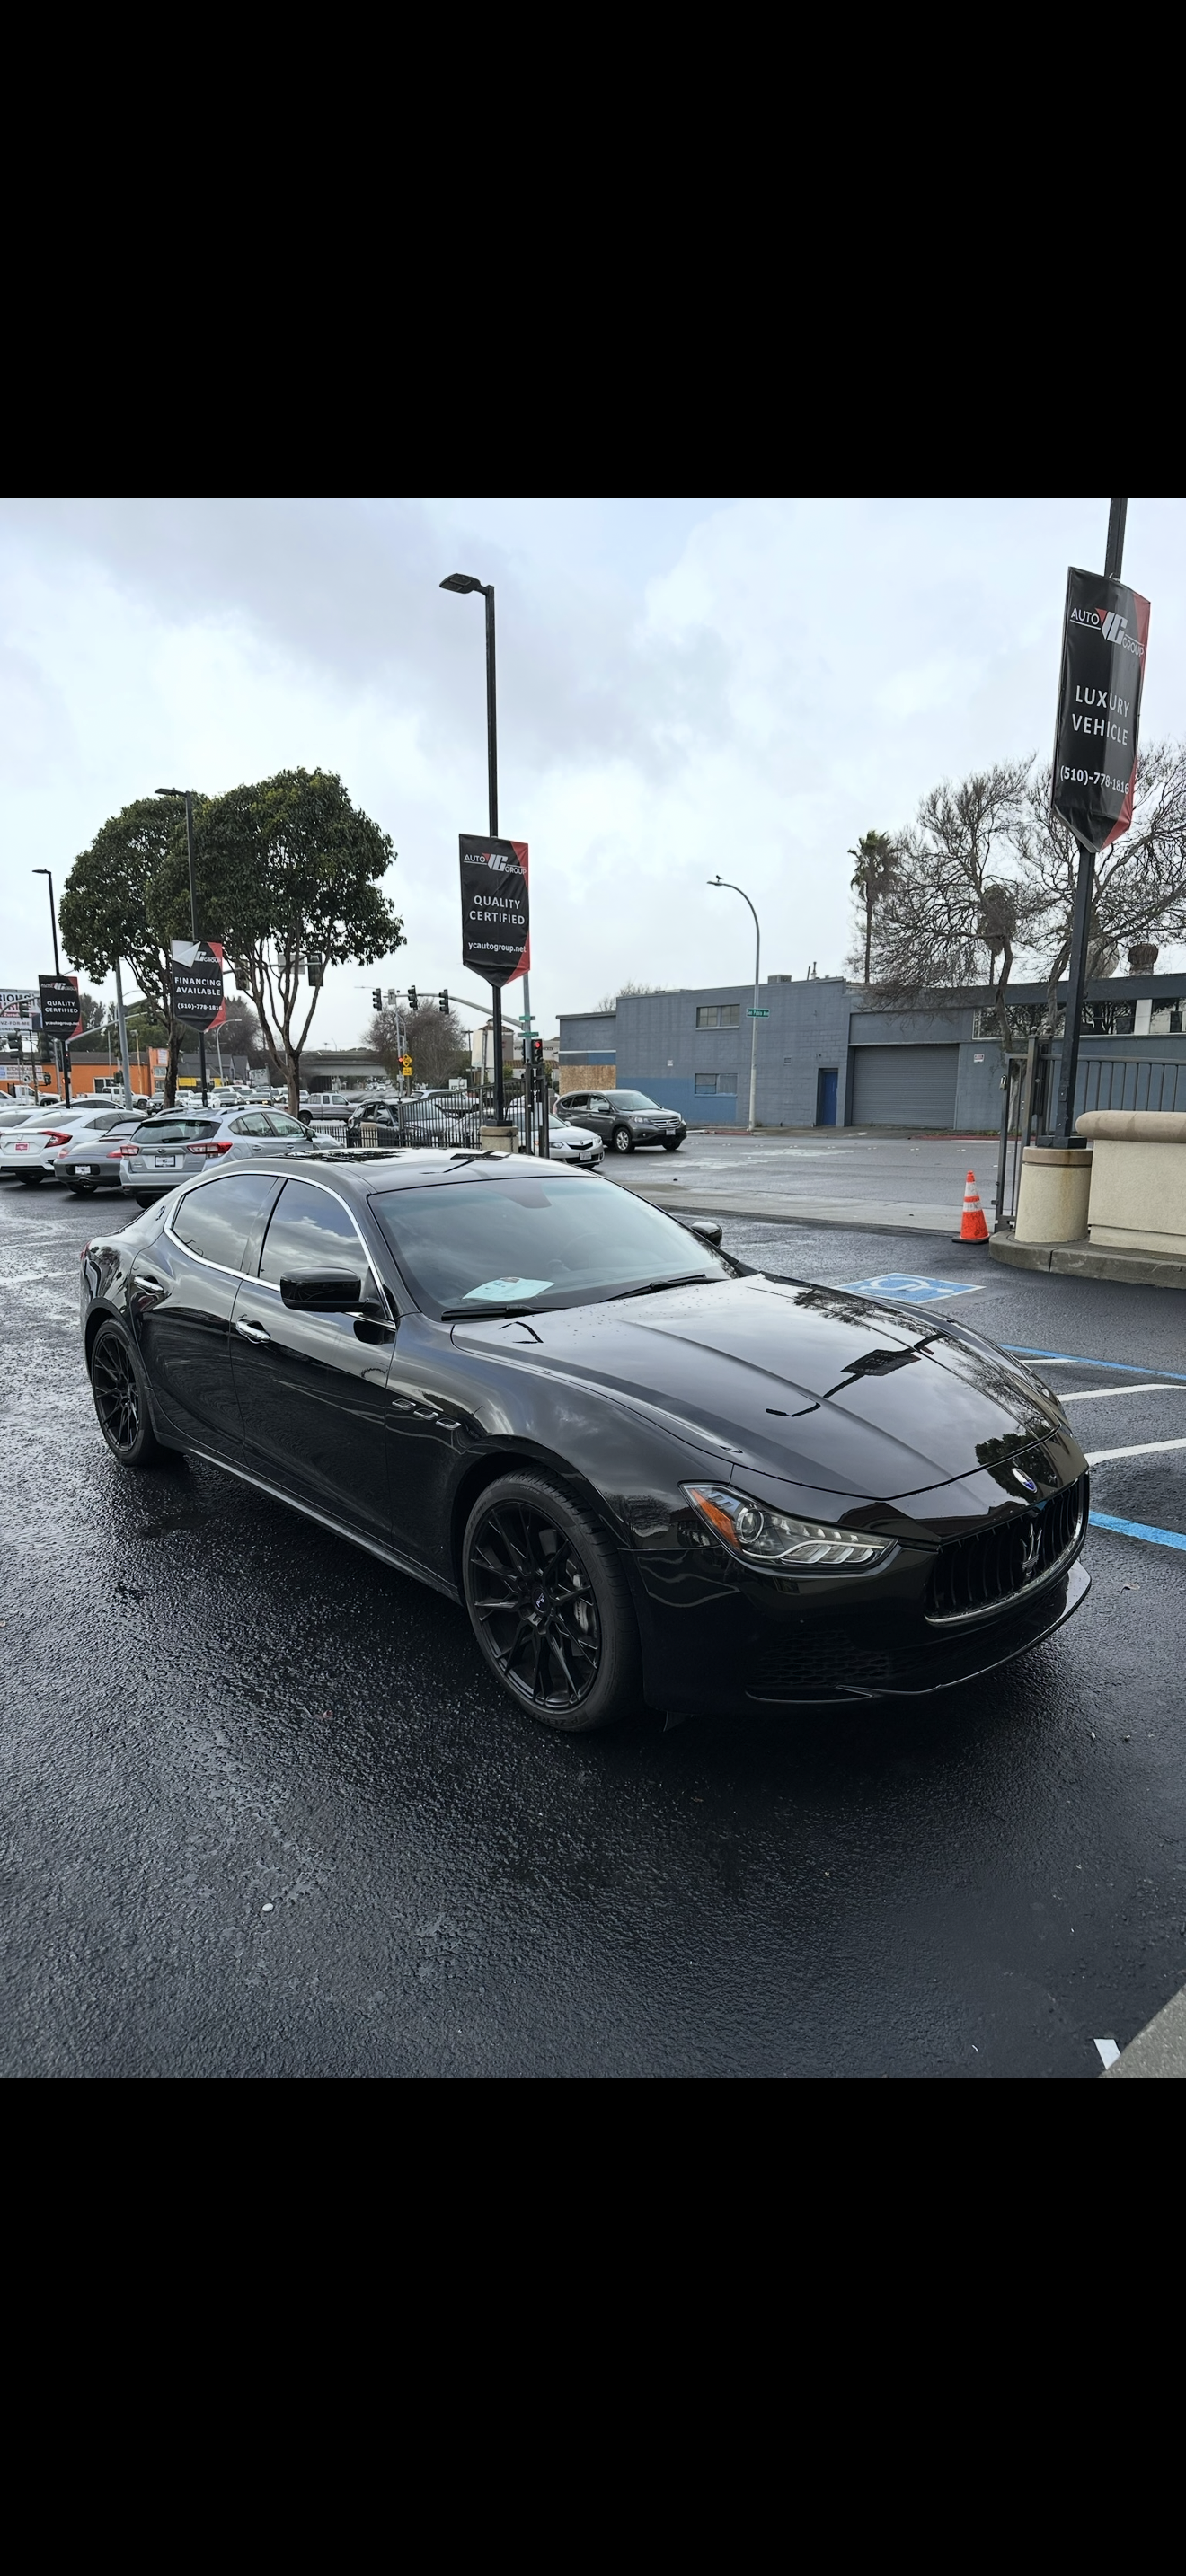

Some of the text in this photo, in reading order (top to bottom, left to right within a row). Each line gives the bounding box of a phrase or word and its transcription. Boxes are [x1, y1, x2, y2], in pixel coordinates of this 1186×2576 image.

[1070, 607, 1100, 626] AUTO
[1122, 636, 1145, 657] GROUP
[1075, 685, 1130, 718] LUXURY
[1072, 713, 1128, 745] VEHICLE
[1060, 765, 1129, 795] (510)-778-1816
[464, 854, 486, 863] AUTO
[505, 866, 527, 875] GROUP
[474, 895, 520, 910] QUALITY
[469, 911, 526, 925] CERTIFIED
[468, 941, 527, 953] ycautogroup.net
[174, 977, 222, 987] FINANCING
[176, 987, 221, 996] AVAILABLE
[177, 1003, 223, 1011] (510)-778-1816
